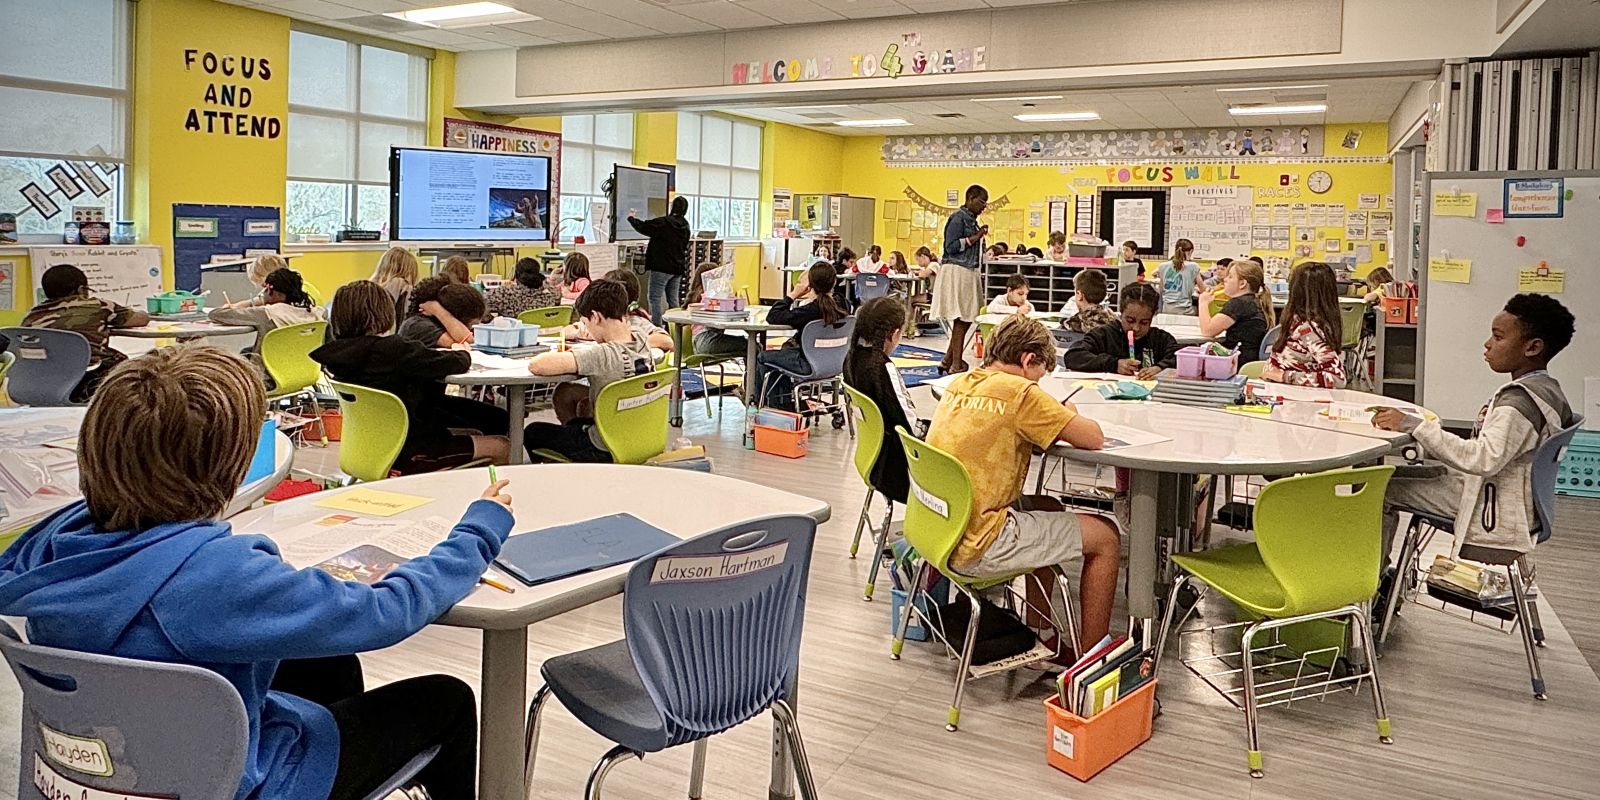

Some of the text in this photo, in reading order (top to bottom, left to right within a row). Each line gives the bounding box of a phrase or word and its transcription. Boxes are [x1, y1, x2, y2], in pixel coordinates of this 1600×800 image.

[184, 49, 271, 80] FOCUS
[732, 43, 987, 85] WELCOME TO 4 GRADE
[204, 83, 252, 108] AND
[184, 108, 281, 139] ATTEND
[471, 132, 537, 153] HAPPINESS
[1105, 165, 1240, 183] FOCUS WALL
[1187, 187, 1234, 195] OBJECTIVES
[1258, 187, 1301, 198] RACES
[621, 350, 631, 378] UTICA
[660, 555, 775, 580] Jaxson Hartman
[48, 740, 102, 765] Hayden
